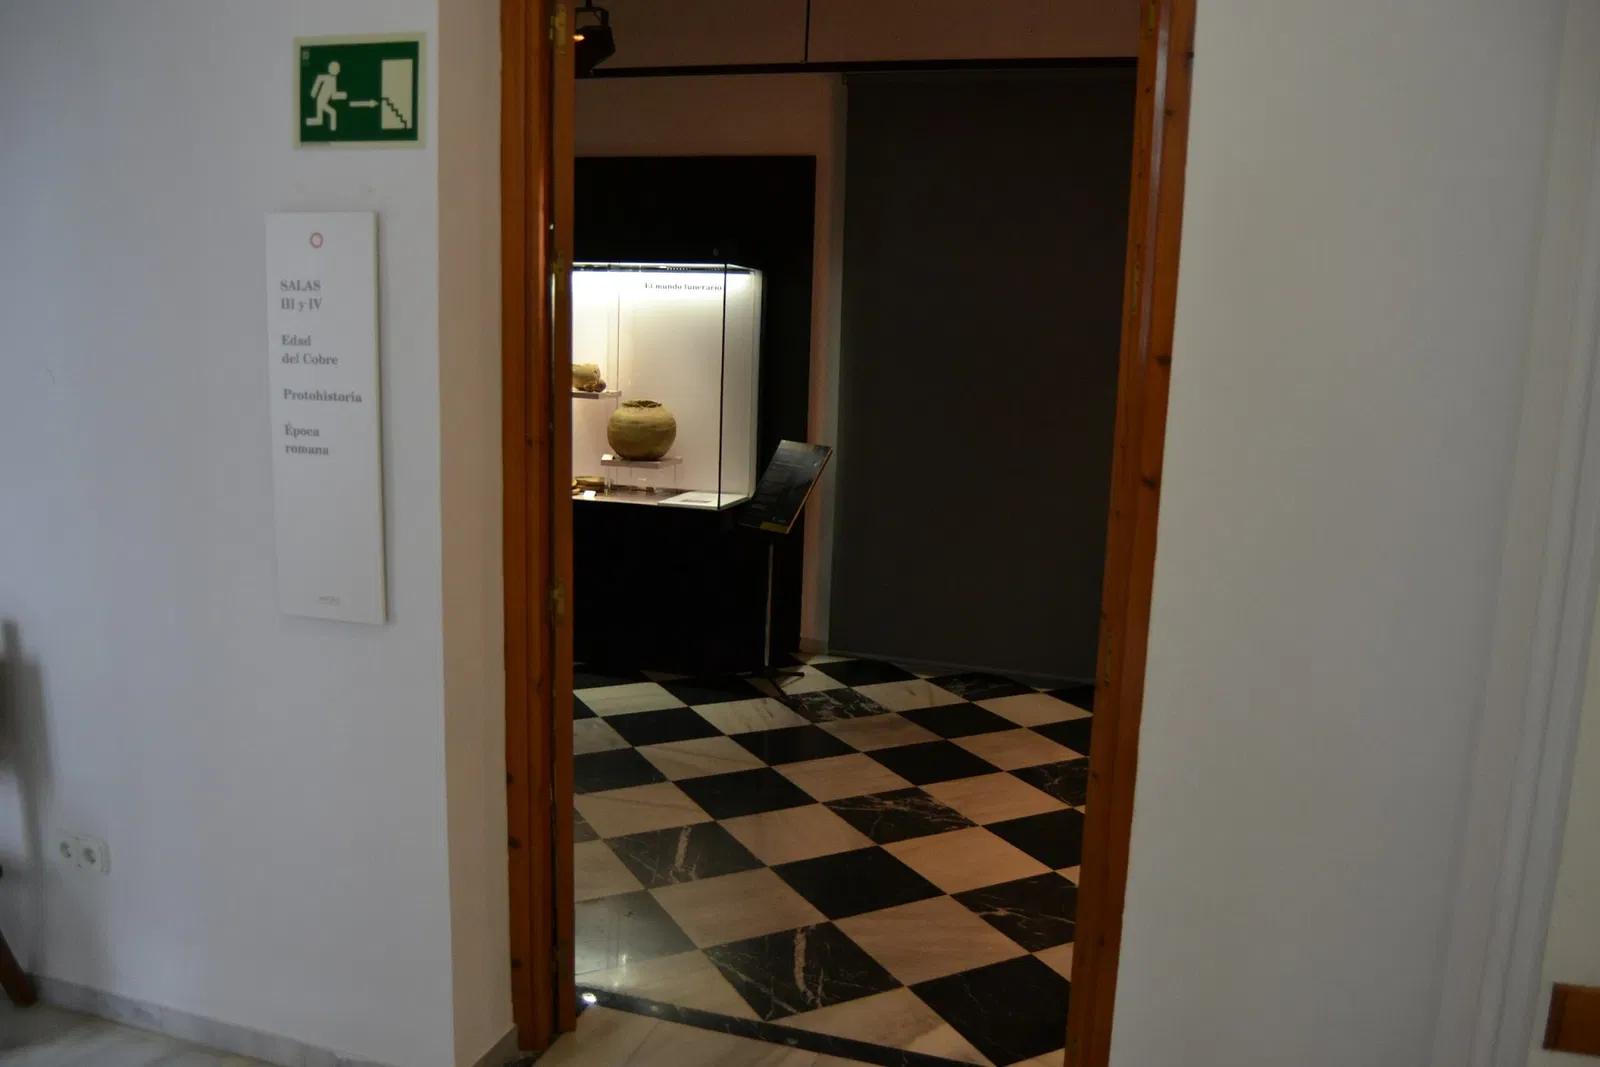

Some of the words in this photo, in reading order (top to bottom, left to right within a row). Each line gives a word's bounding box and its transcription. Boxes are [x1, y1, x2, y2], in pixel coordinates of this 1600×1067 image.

[280, 280, 321, 291] SALAS
[684, 283, 722, 291] funerario
[281, 298, 295, 310] III
[298, 301, 306, 312] y
[309, 298, 322, 310] IV
[281, 335, 312, 346] Edad
[281, 353, 299, 364] del
[303, 353, 338, 365] Cobre
[283, 388, 362, 402] Protohistoria
[284, 422, 320, 438] Época
[285, 445, 329, 456] romana
